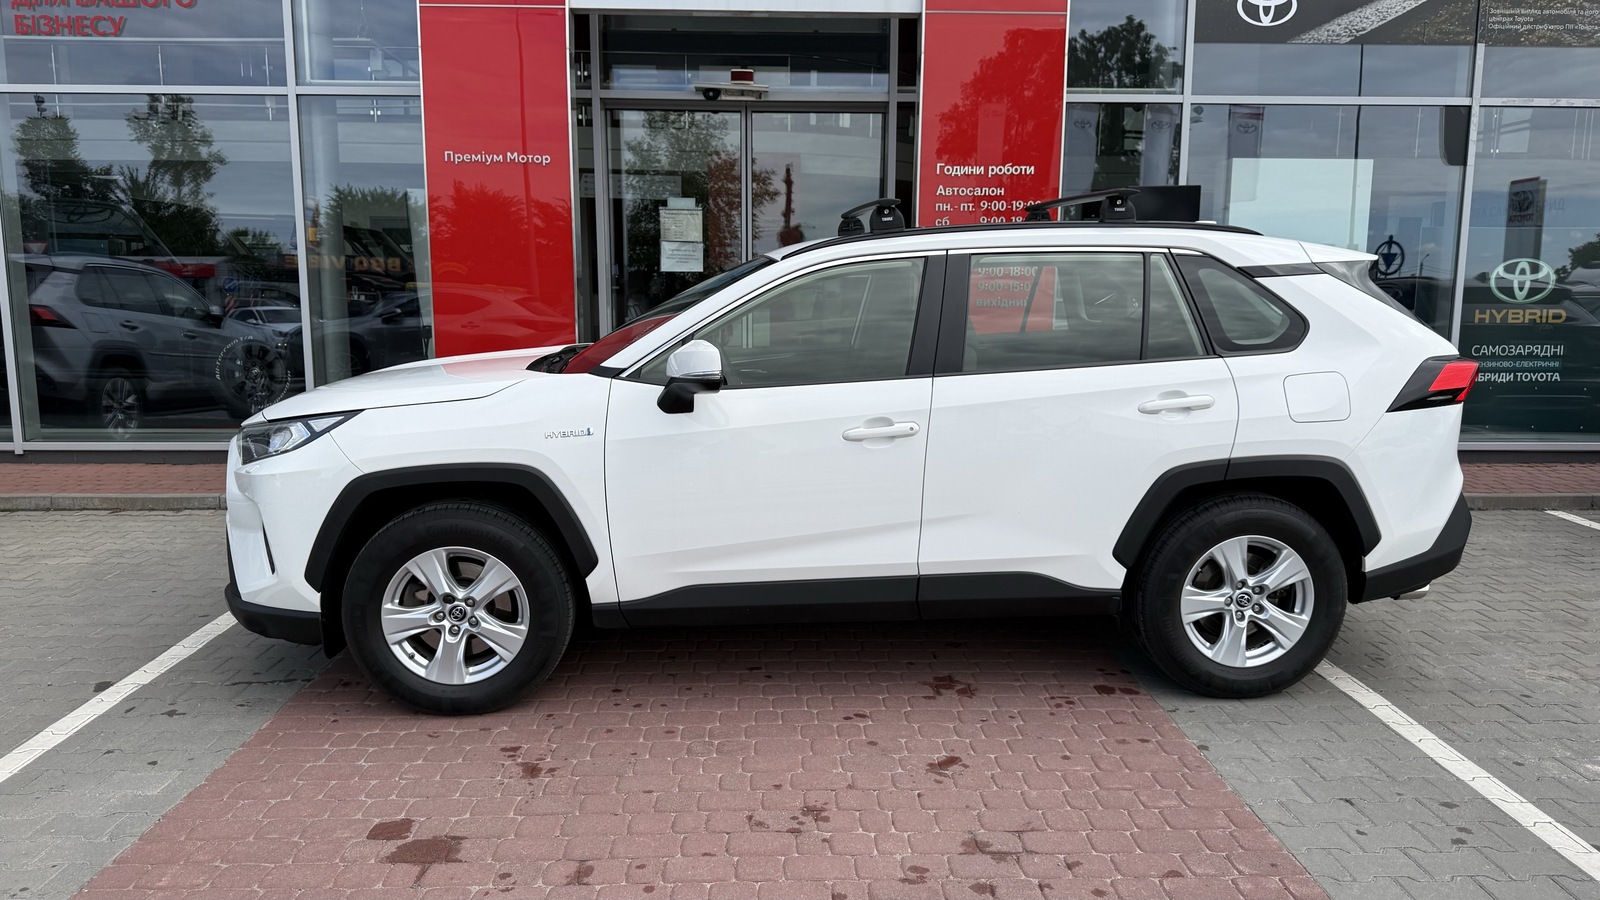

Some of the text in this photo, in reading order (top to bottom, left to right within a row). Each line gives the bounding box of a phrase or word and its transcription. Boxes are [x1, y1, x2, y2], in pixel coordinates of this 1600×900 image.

[14, 14, 125, 36] БІЗНЕСУ
[444, 150, 551, 166] Преміум Мотор
[936, 163, 1035, 177] Години роботи
[936, 184, 1005, 196] Автосалон
[980, 200, 1042, 211] 9:00-19:
[978, 281, 1031, 291] 9:00-15:0
[1474, 308, 1567, 324] HYBRID
[1471, 345, 1564, 357] САМОЗАРЯДНІ
[1475, 372, 1561, 383] БРИДИ TOYOTA
